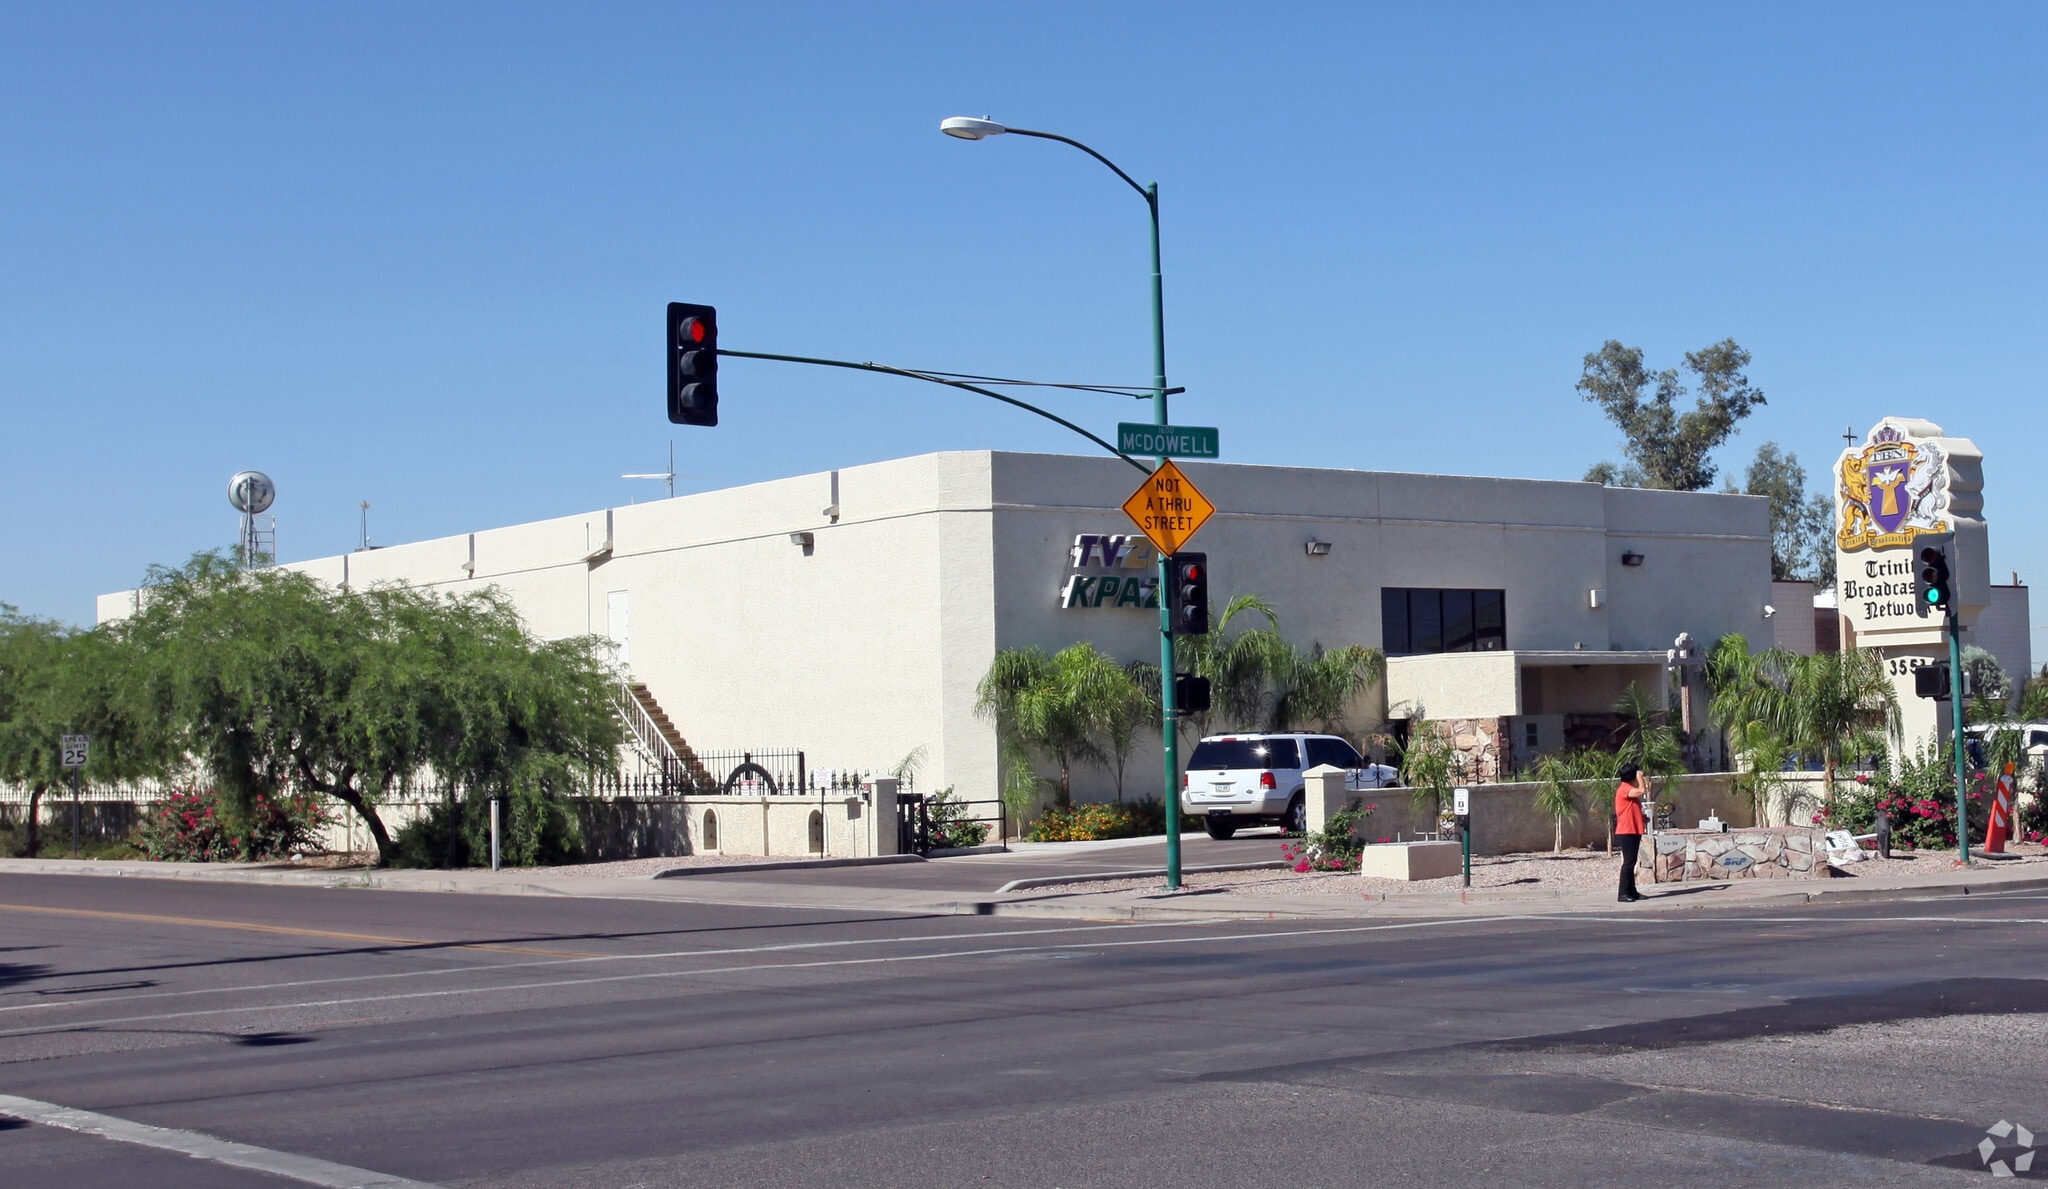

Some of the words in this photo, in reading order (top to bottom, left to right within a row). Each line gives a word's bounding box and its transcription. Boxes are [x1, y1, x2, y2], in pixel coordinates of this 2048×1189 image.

[1158, 427, 1175, 435] 1600
[1870, 449, 1905, 462] TBN
[1156, 478, 1181, 492] NOT
[1146, 497, 1154, 511] A
[1158, 497, 1192, 512] THRU
[1144, 515, 1193, 530] STREET
[1843, 580, 1915, 602] Broadcas
[1863, 601, 1932, 621] Netwo
[65, 750, 87, 765] 25
